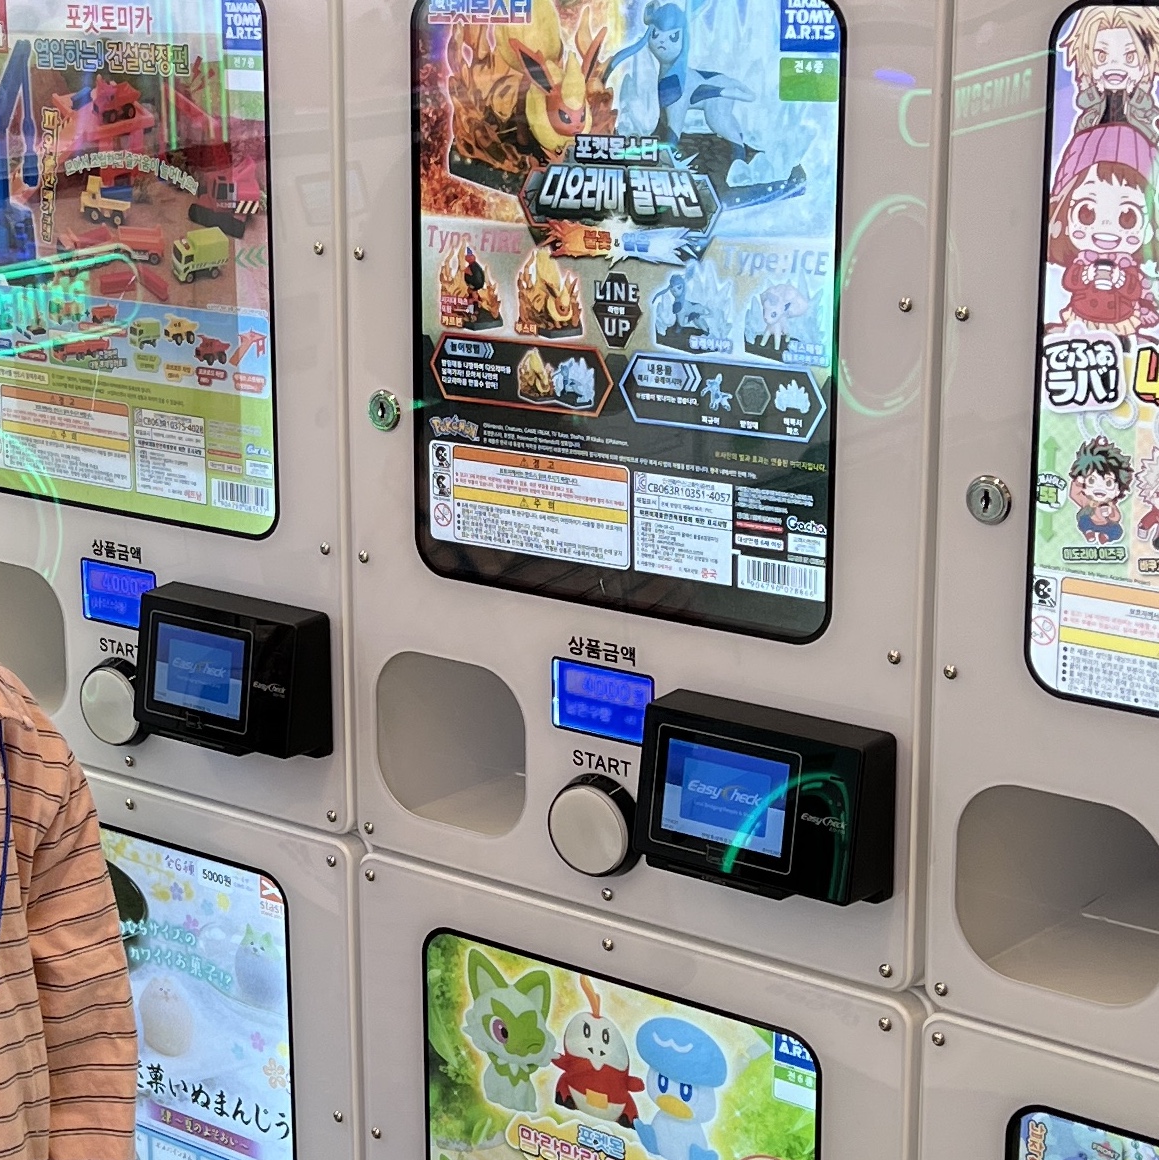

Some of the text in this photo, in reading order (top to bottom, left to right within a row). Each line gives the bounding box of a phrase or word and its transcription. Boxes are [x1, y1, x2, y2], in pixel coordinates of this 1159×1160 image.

[65, 4, 154, 35] 포켓토미카
[225, 14, 262, 27] TOMY
[427, 0, 532, 26] 포켓몬스터
[784, 9, 835, 24] TOMY
[34, 38, 190, 76] 열일하는! 건설현장편
[575, 135, 660, 163] 포켓몬스터
[540, 167, 704, 220] 디오라마 컬렉션
[582, 229, 613, 251] 불꽃
[622, 232, 651, 253] 얼음
[594, 280, 640, 301] LINE
[603, 318, 631, 338] UP
[647, 363, 673, 376] 내용물
[1047, 367, 1117, 404] ラバ!
[647, 482, 731, 503] CB063R10351-4057
[92, 538, 143, 564] 상품금액
[567, 636, 637, 667] 상품금액
[572, 749, 632, 778] START
[577, 1125, 626, 1160] 포켓몬
[1092, 1141, 1121, 1160] FRONT
